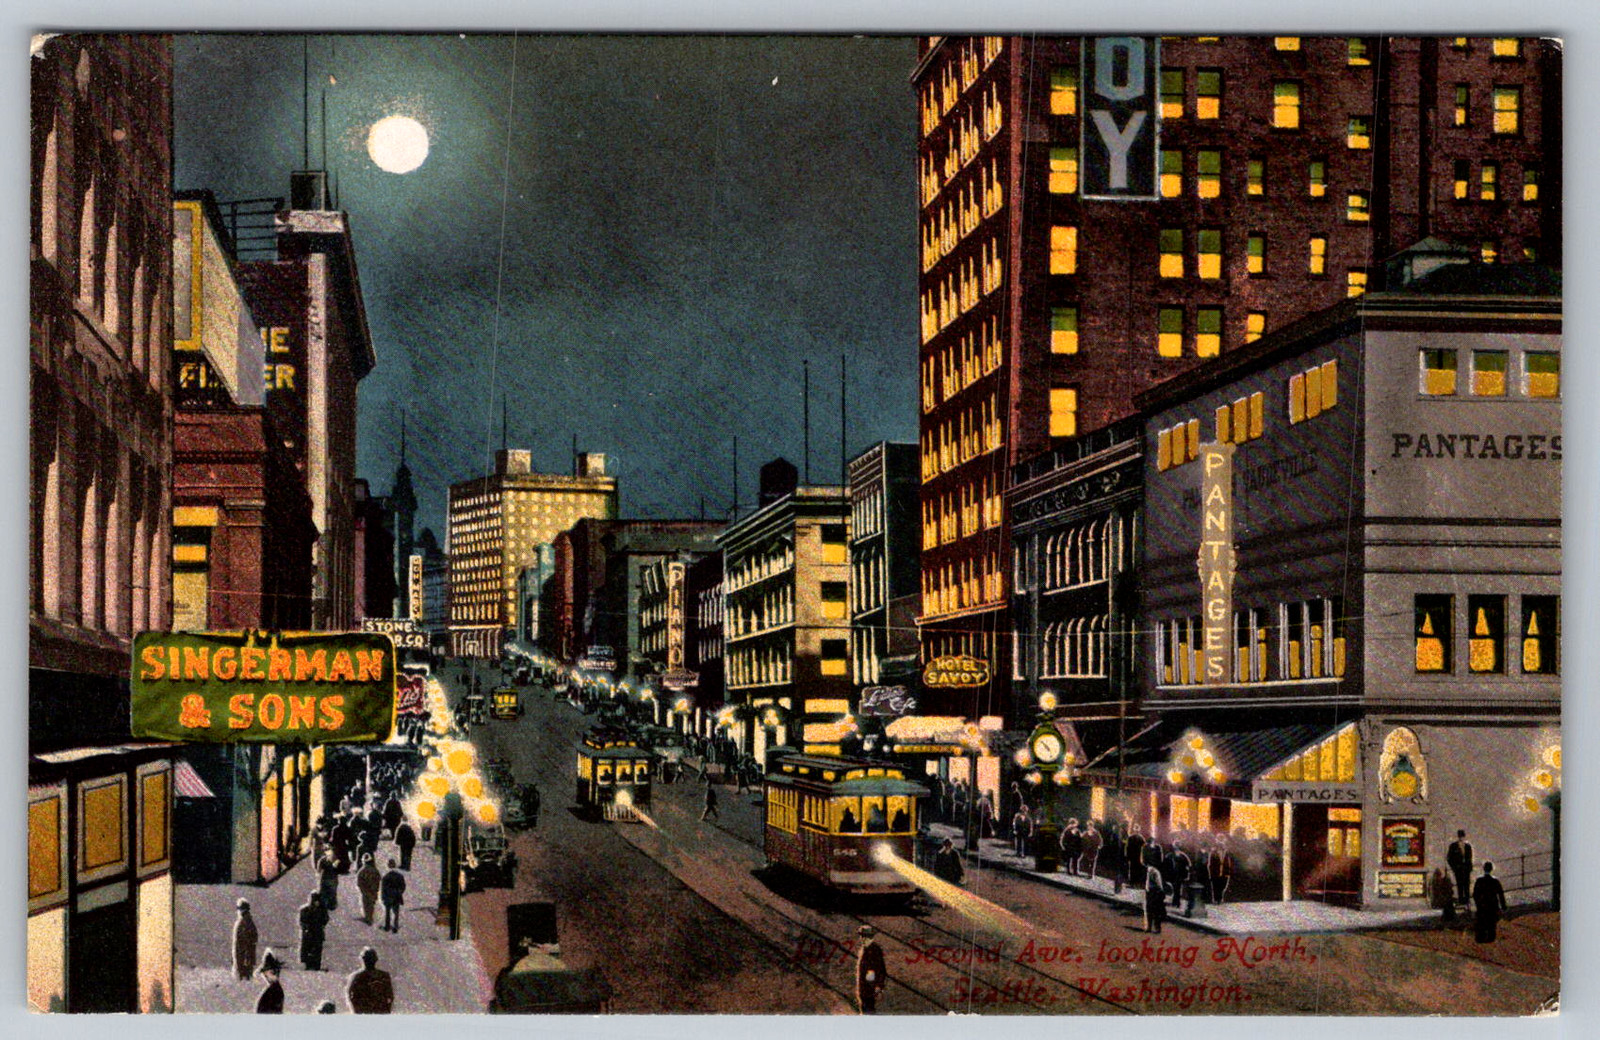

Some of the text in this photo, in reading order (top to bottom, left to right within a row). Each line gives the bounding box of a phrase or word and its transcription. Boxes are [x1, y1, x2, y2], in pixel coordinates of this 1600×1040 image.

[1391, 433, 1562, 460] PANTAGES
[1205, 452, 1225, 679] PANTAGES
[365, 620, 413, 634] STONE
[140, 646, 386, 682] SINGERMAN
[936, 658, 979, 672] HOTEL
[927, 671, 985, 685] SAVOY
[179, 693, 347, 730] & SONS
[1258, 788, 1358, 801] PANTAGES
